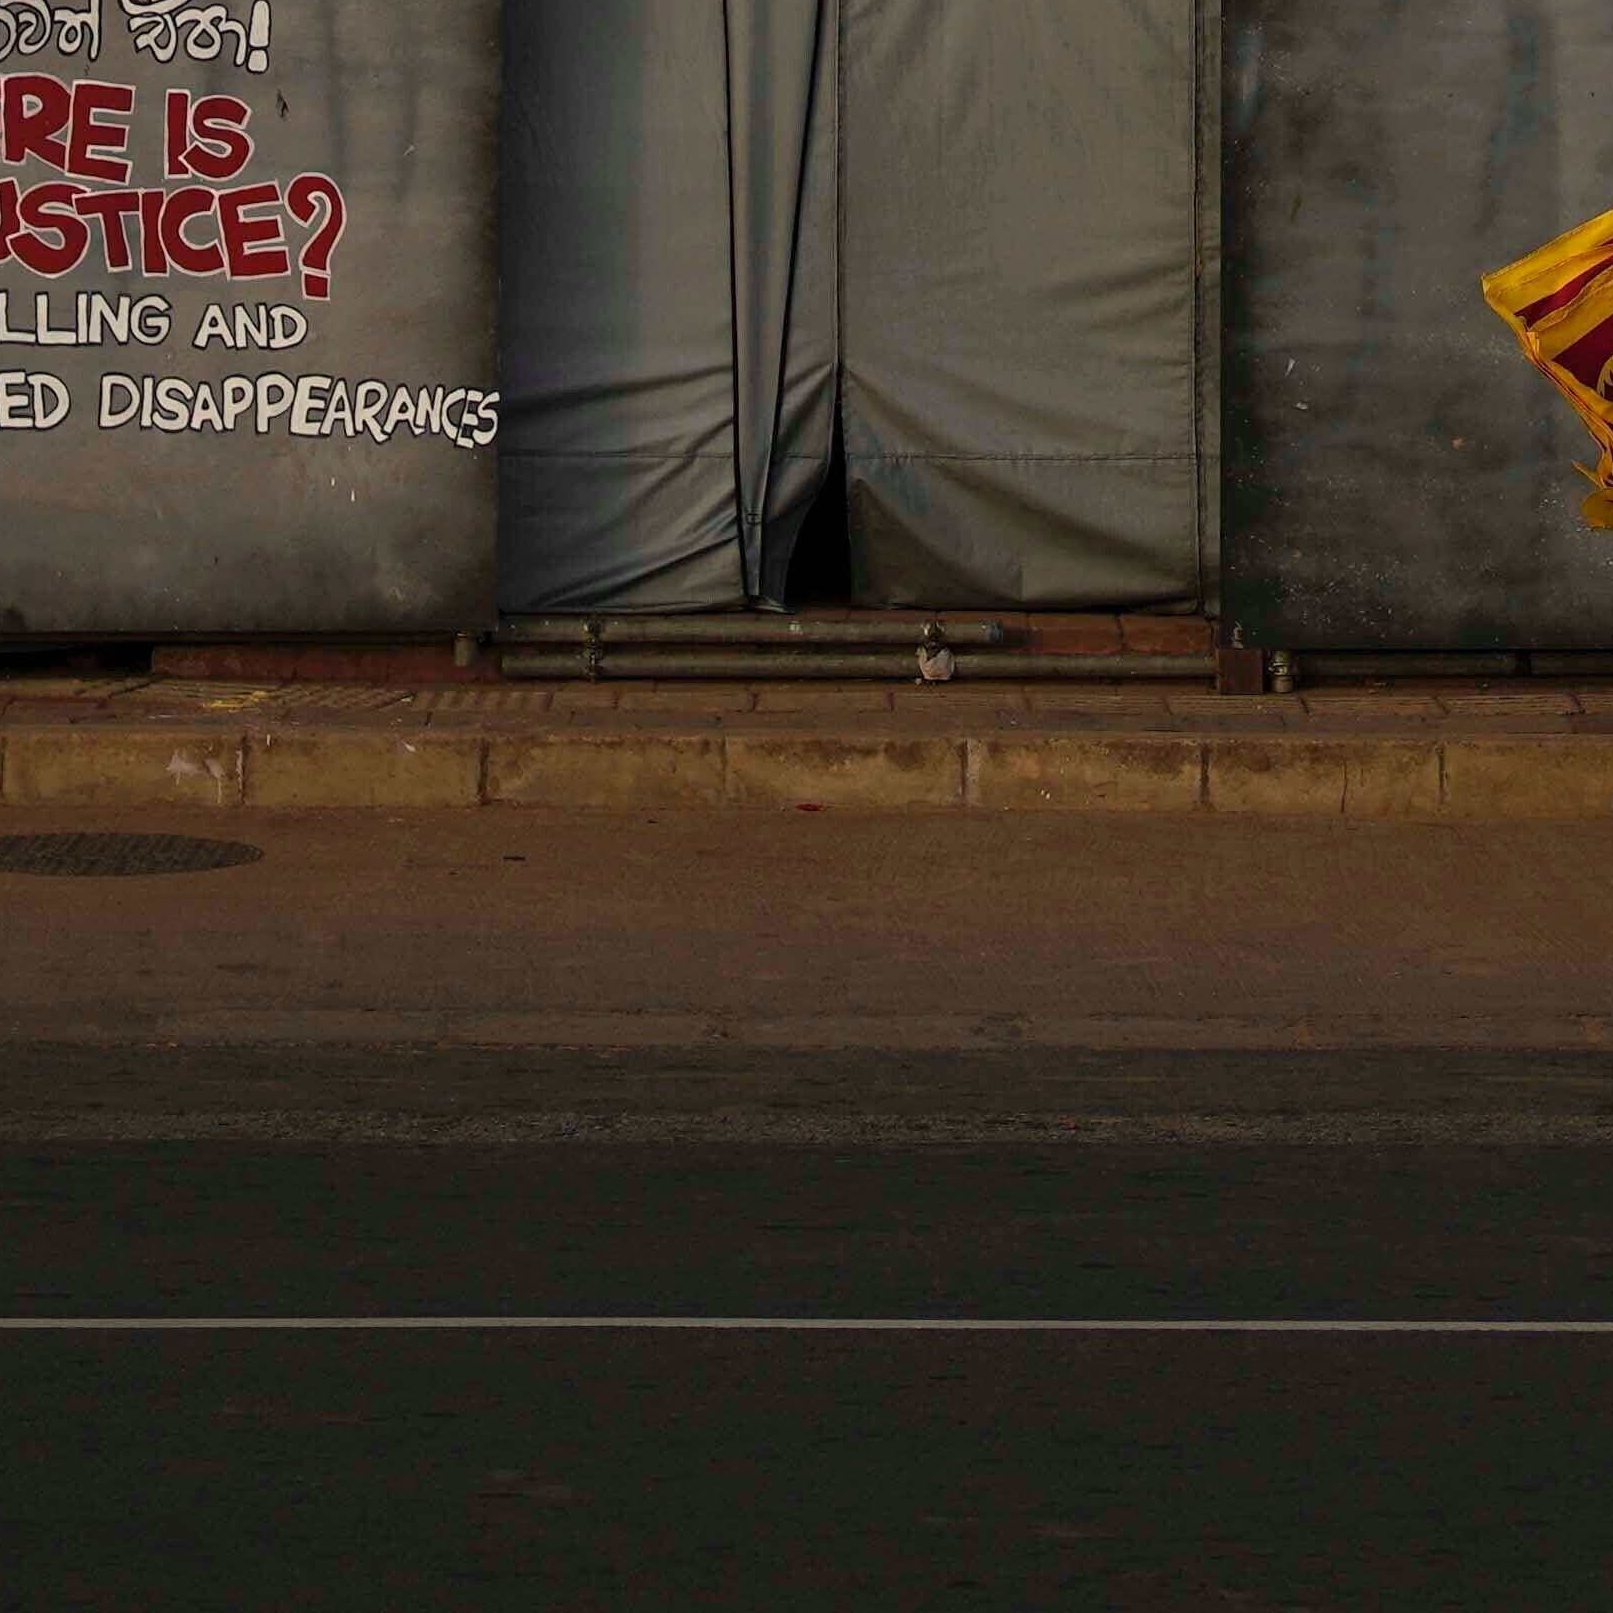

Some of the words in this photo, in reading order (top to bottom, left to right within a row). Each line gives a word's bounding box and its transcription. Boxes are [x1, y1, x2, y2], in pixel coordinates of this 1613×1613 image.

[164, 86, 254, 180] IS
[191, 301, 309, 351] AND
[98, 372, 500, 450] DISAPPEARANCES
